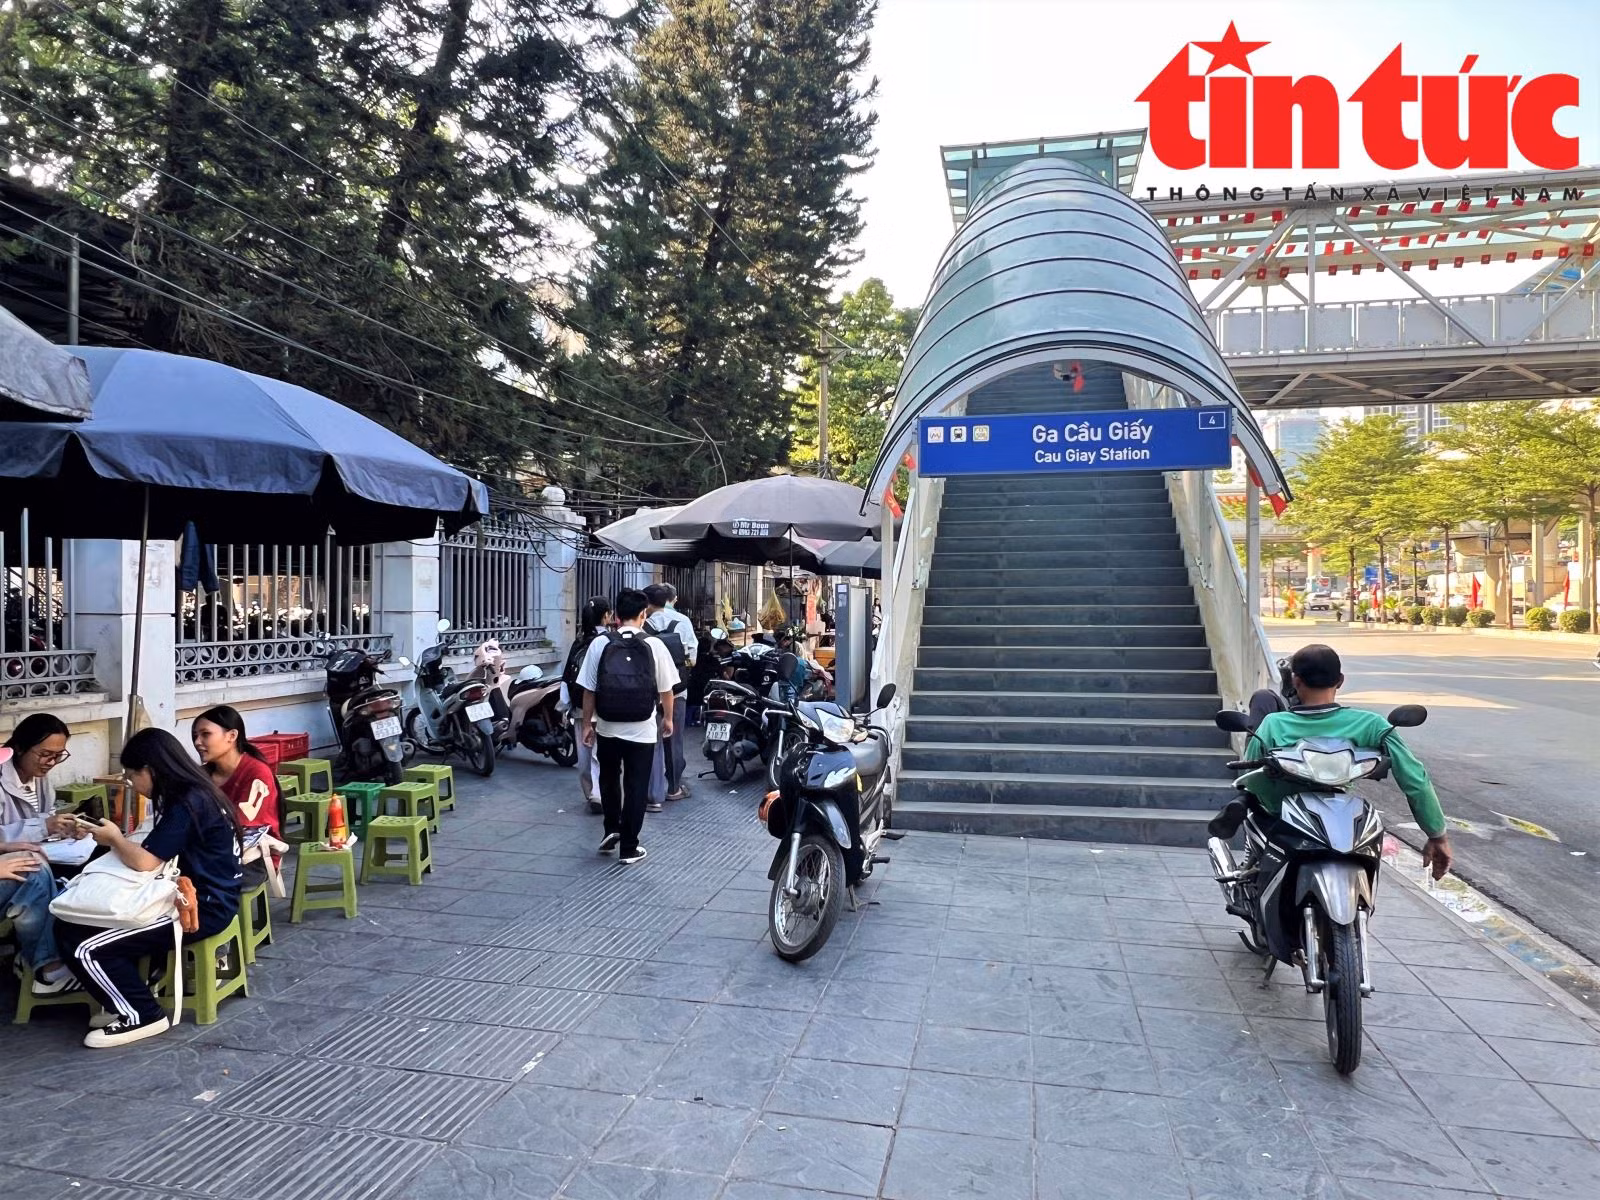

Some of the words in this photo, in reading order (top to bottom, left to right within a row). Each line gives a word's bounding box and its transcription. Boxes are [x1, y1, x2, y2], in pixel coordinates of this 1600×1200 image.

[1208, 415, 1216, 425] 4
[1032, 424, 1059, 444] Ga
[1064, 421, 1102, 443] Cầu
[1108, 418, 1153, 445] Giấy
[1034, 449, 1062, 463] Cau
[1066, 449, 1096, 465] Giay
[1100, 448, 1150, 462] Station
